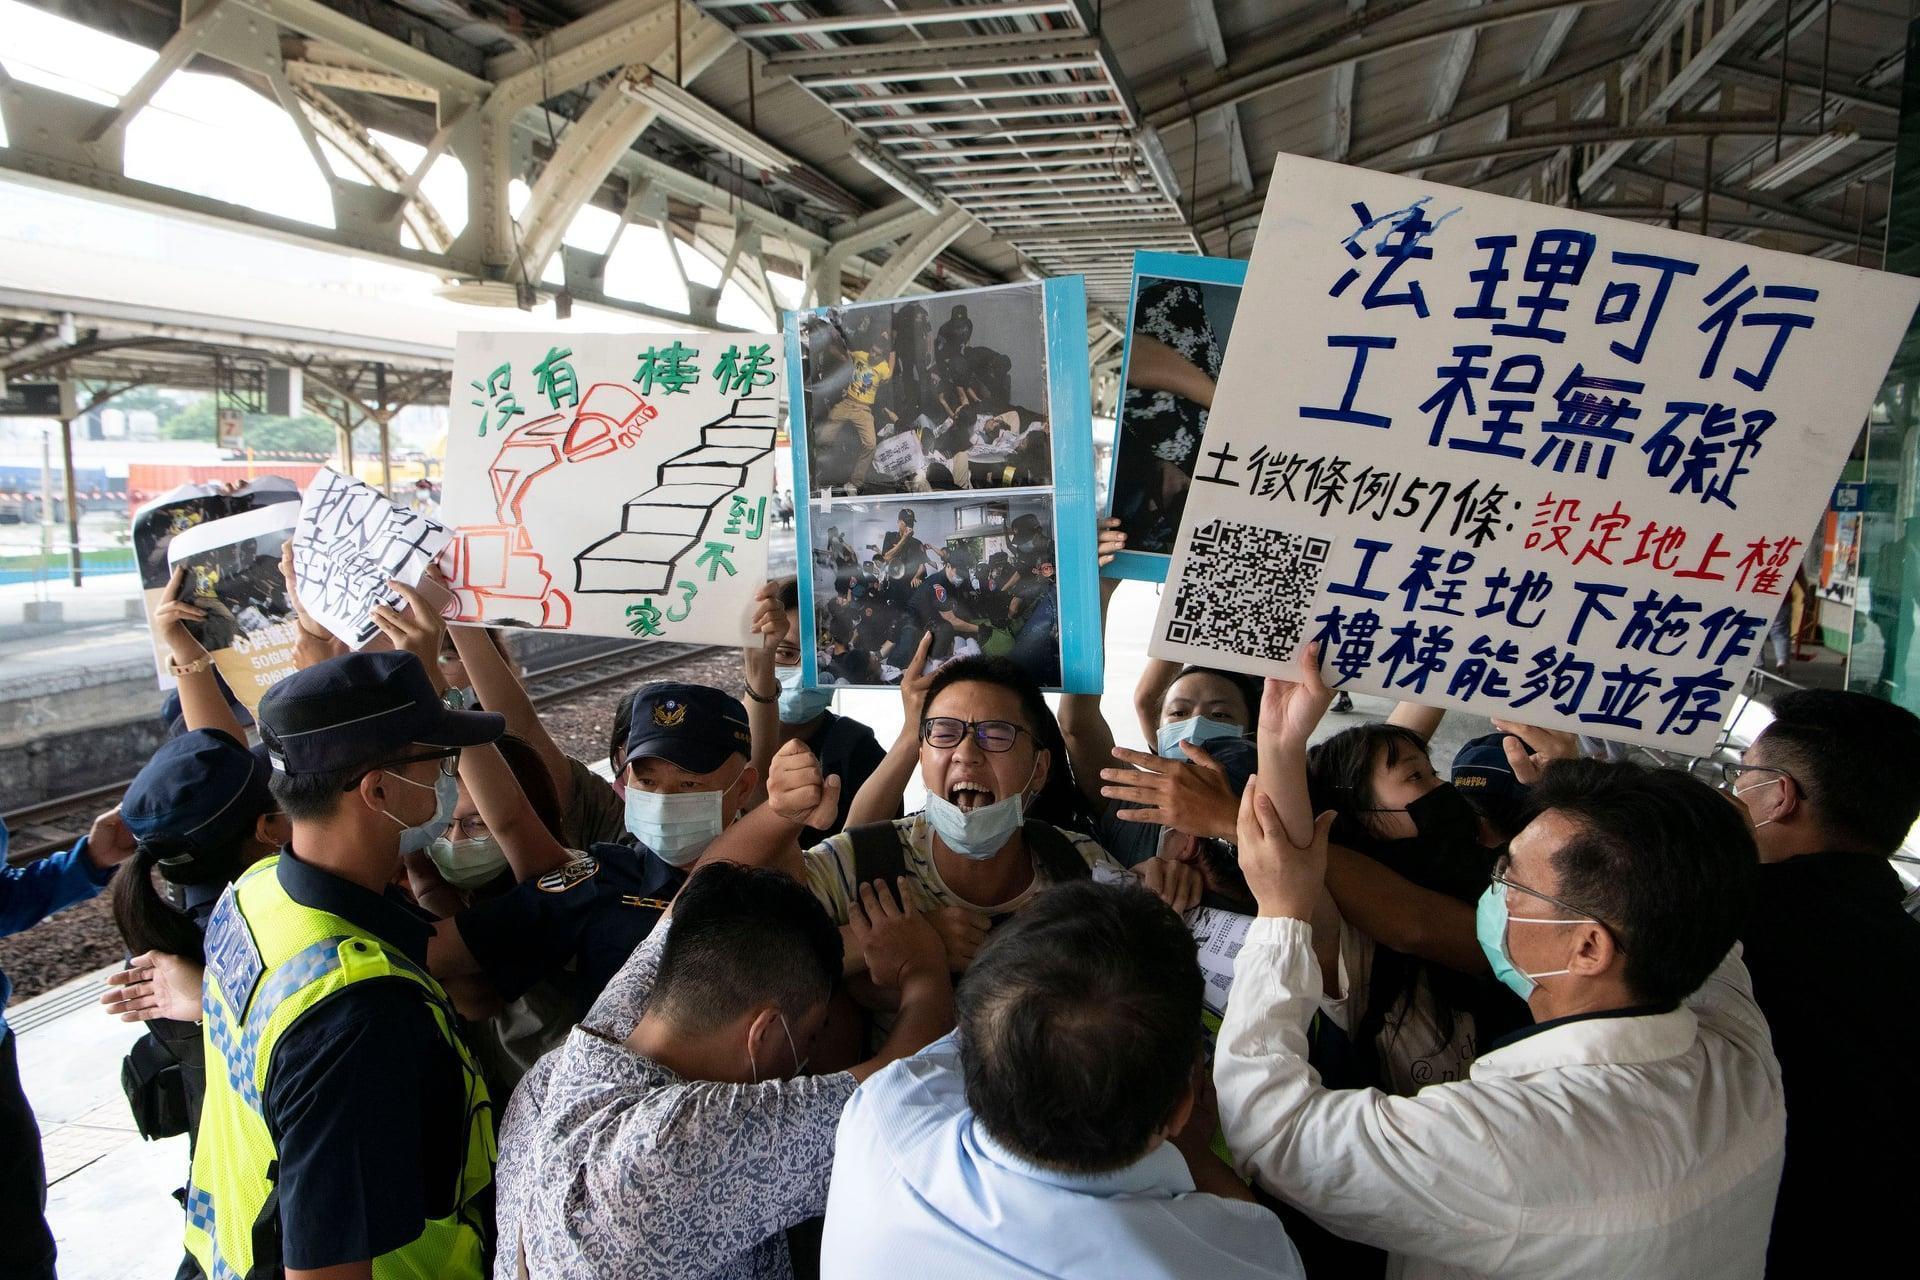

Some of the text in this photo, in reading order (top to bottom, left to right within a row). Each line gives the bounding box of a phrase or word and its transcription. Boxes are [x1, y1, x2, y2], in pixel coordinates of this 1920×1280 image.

[1329, 200, 1819, 392] 法理可行
[1299, 335, 1777, 510] 工程無礙
[1313, 605, 1735, 736] 樓梯能夠並存
[1327, 538, 1767, 666] 工程地下施作
